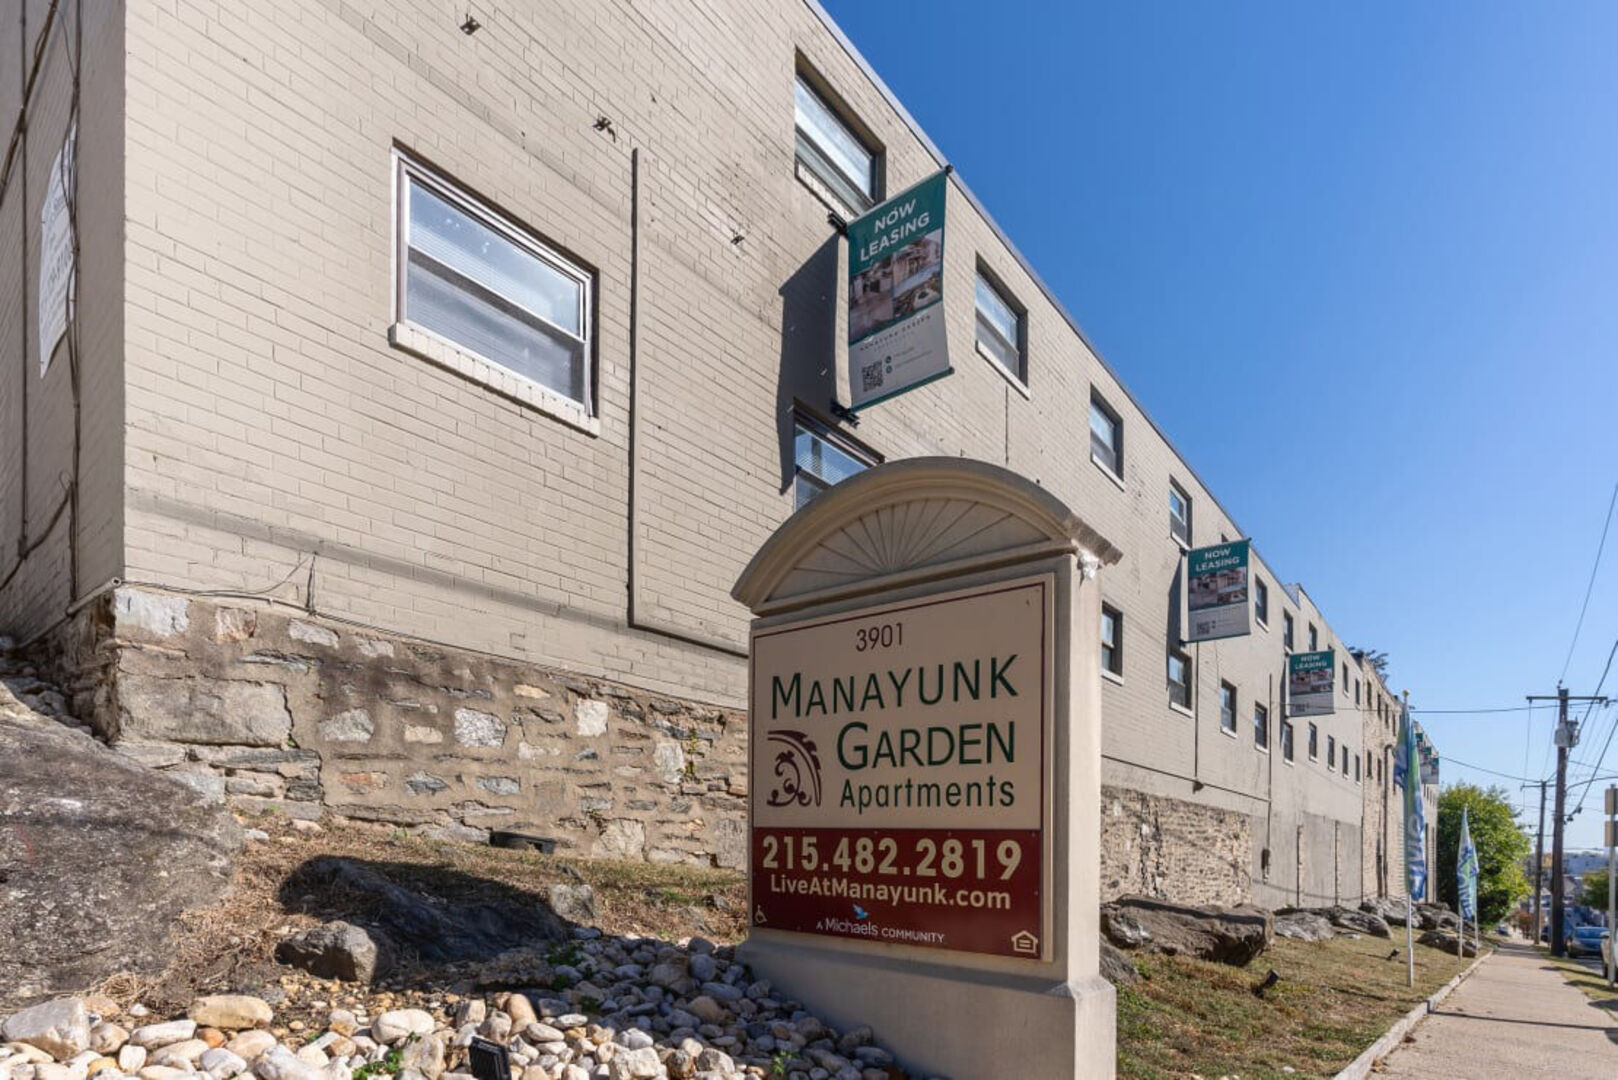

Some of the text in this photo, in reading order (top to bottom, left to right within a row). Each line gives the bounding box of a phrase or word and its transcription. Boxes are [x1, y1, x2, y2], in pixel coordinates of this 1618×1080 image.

[874, 198, 917, 234] NOW
[860, 212, 930, 262] LEASING
[1196, 557, 1240, 572] LEASING
[1204, 547, 1231, 560] NOW
[856, 623, 904, 652] 3901
[1295, 661, 1327, 670] LEASING
[1301, 654, 1320, 662] NOW
[771, 654, 1019, 720] MANAYUNK
[836, 721, 1015, 770] GARDEN
[840, 775, 1015, 815] Apartments
[762, 835, 1022, 881] 215.482.2819
[770, 874, 1011, 910] LiveAtManayunk.com
[816, 917, 945, 943] A Michaels COMMUNITY
